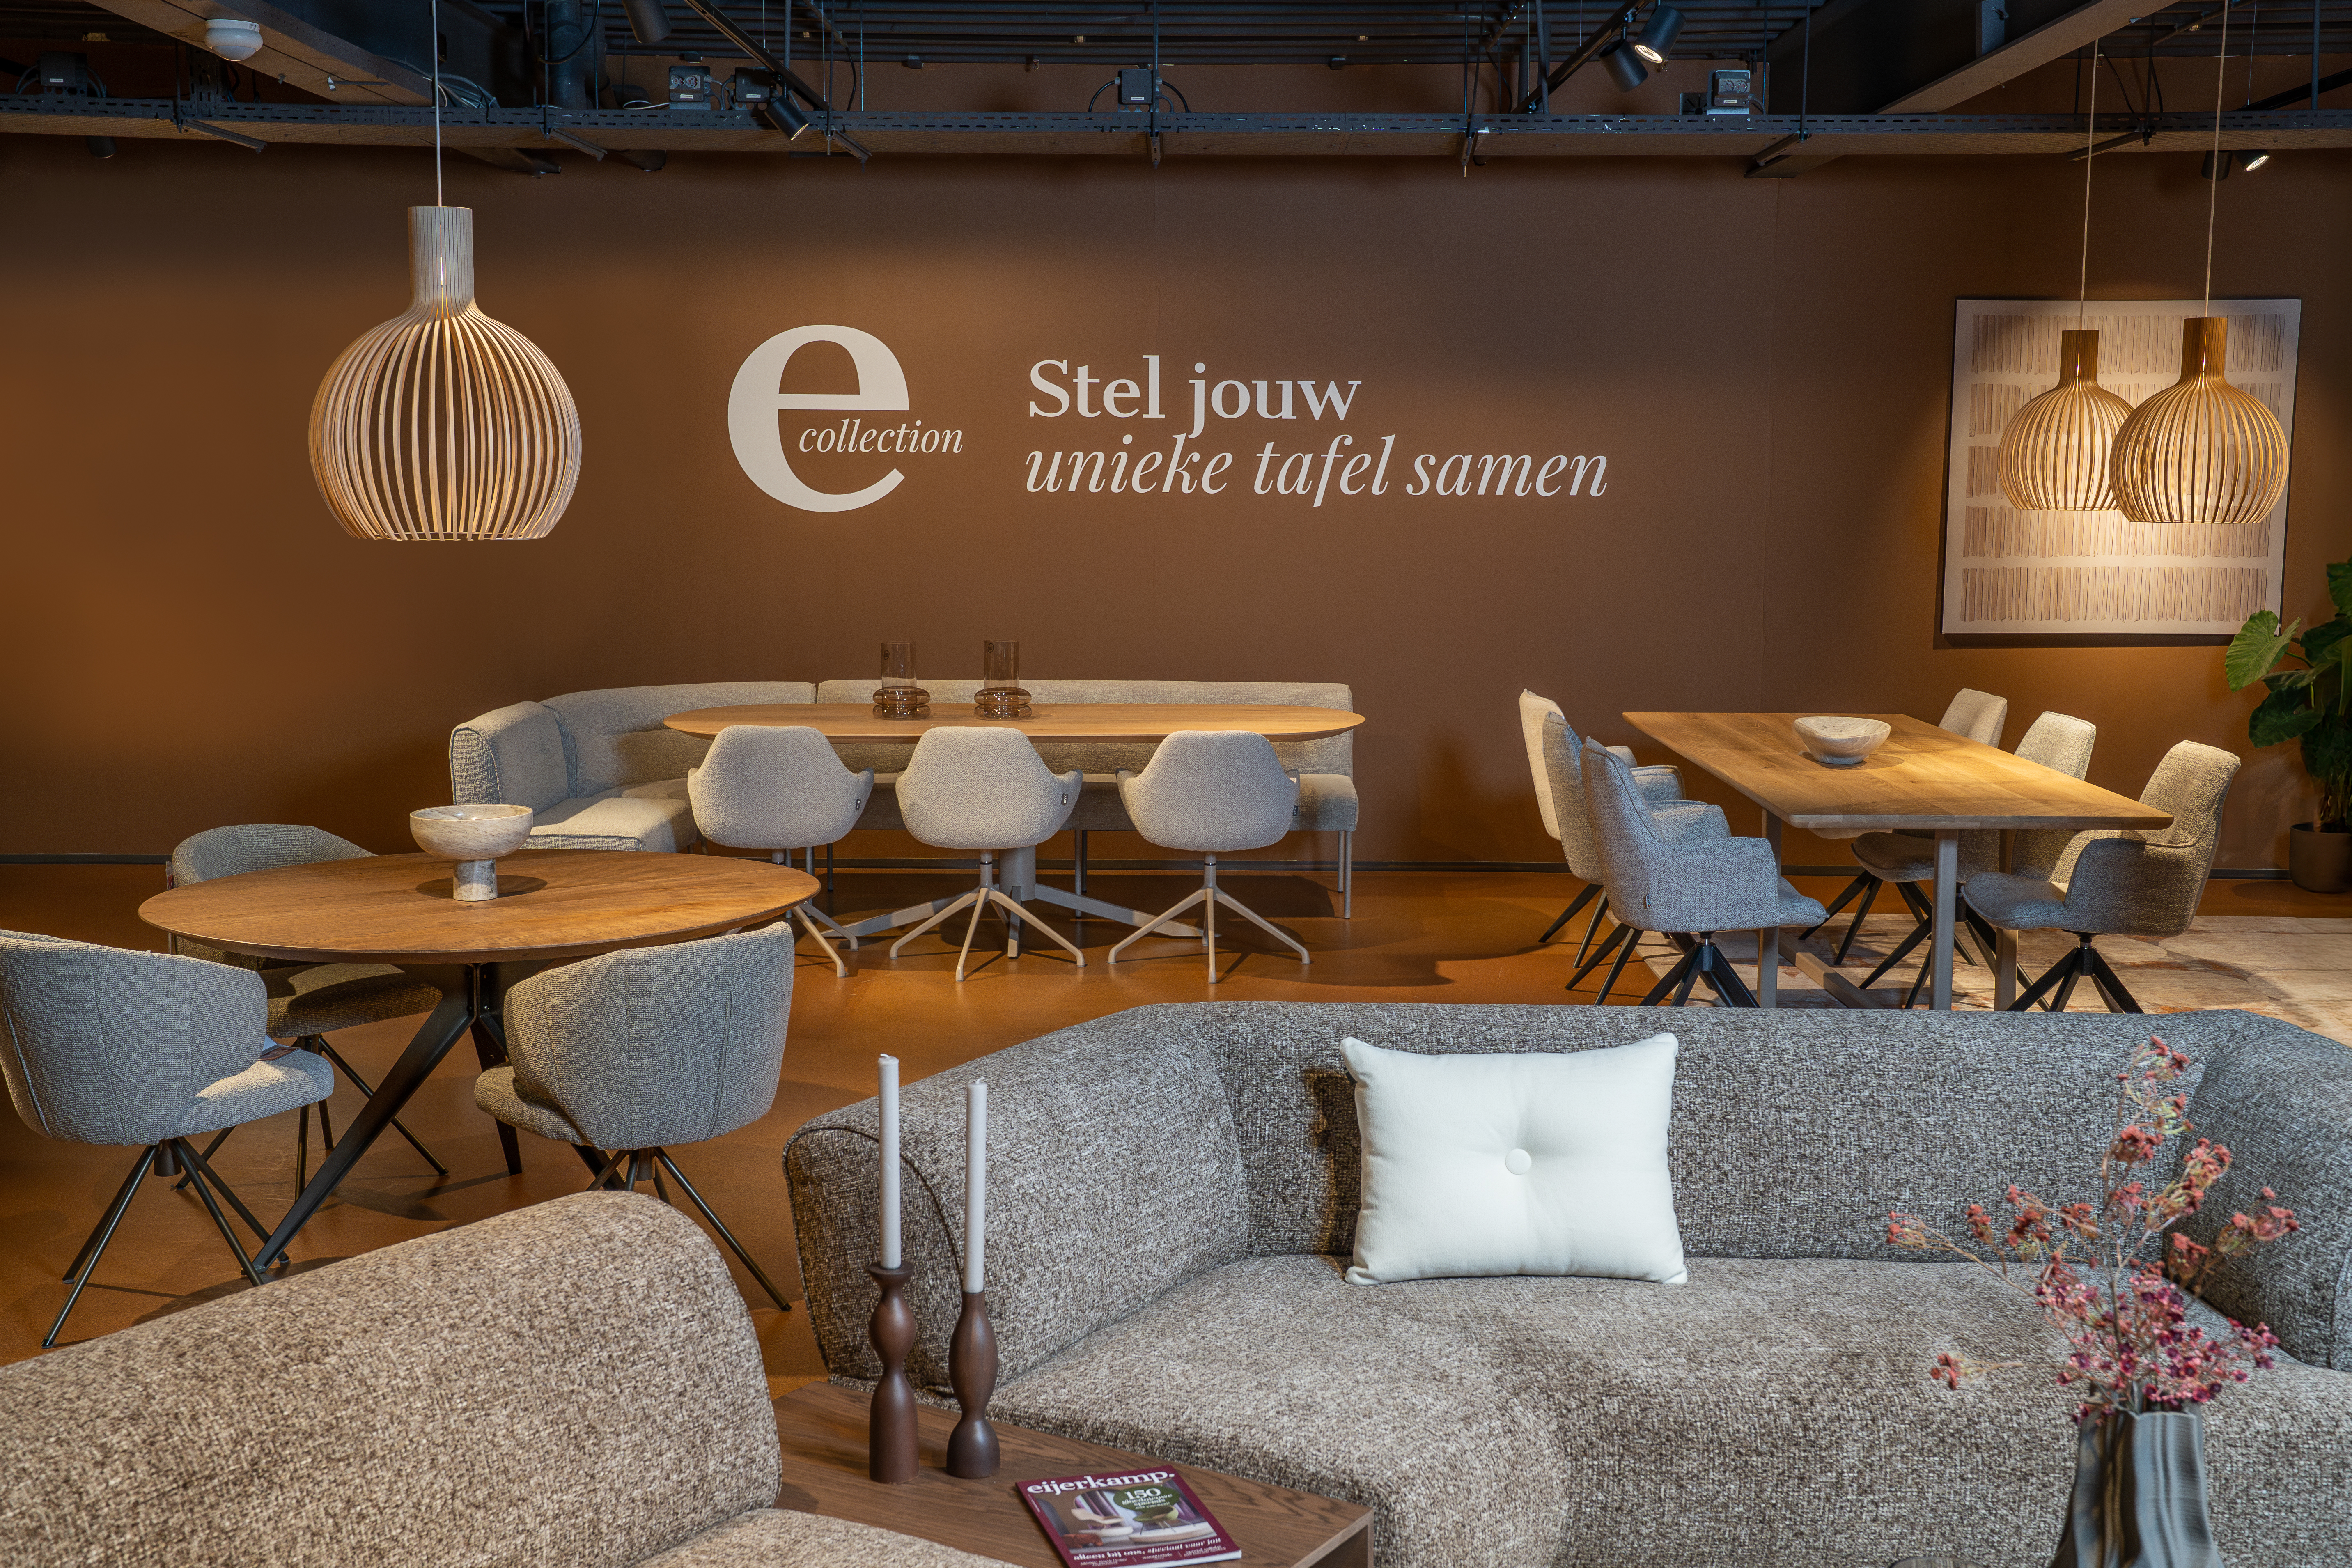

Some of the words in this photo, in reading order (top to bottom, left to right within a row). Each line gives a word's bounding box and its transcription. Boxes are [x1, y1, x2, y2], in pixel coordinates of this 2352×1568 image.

[1030, 355, 1165, 418] Stel
[1188, 363, 1361, 438] jouw
[728, 325, 909, 512] e
[800, 419, 962, 453] collection
[1026, 433, 1232, 494] unieke
[1254, 434, 1395, 507] tafel
[1406, 454, 1607, 496] samen
[1027, 1471, 1175, 1495] eijerkamp.
[1125, 1488, 1161, 1500] 150
[1147, 1544, 1183, 1554] speciaal
